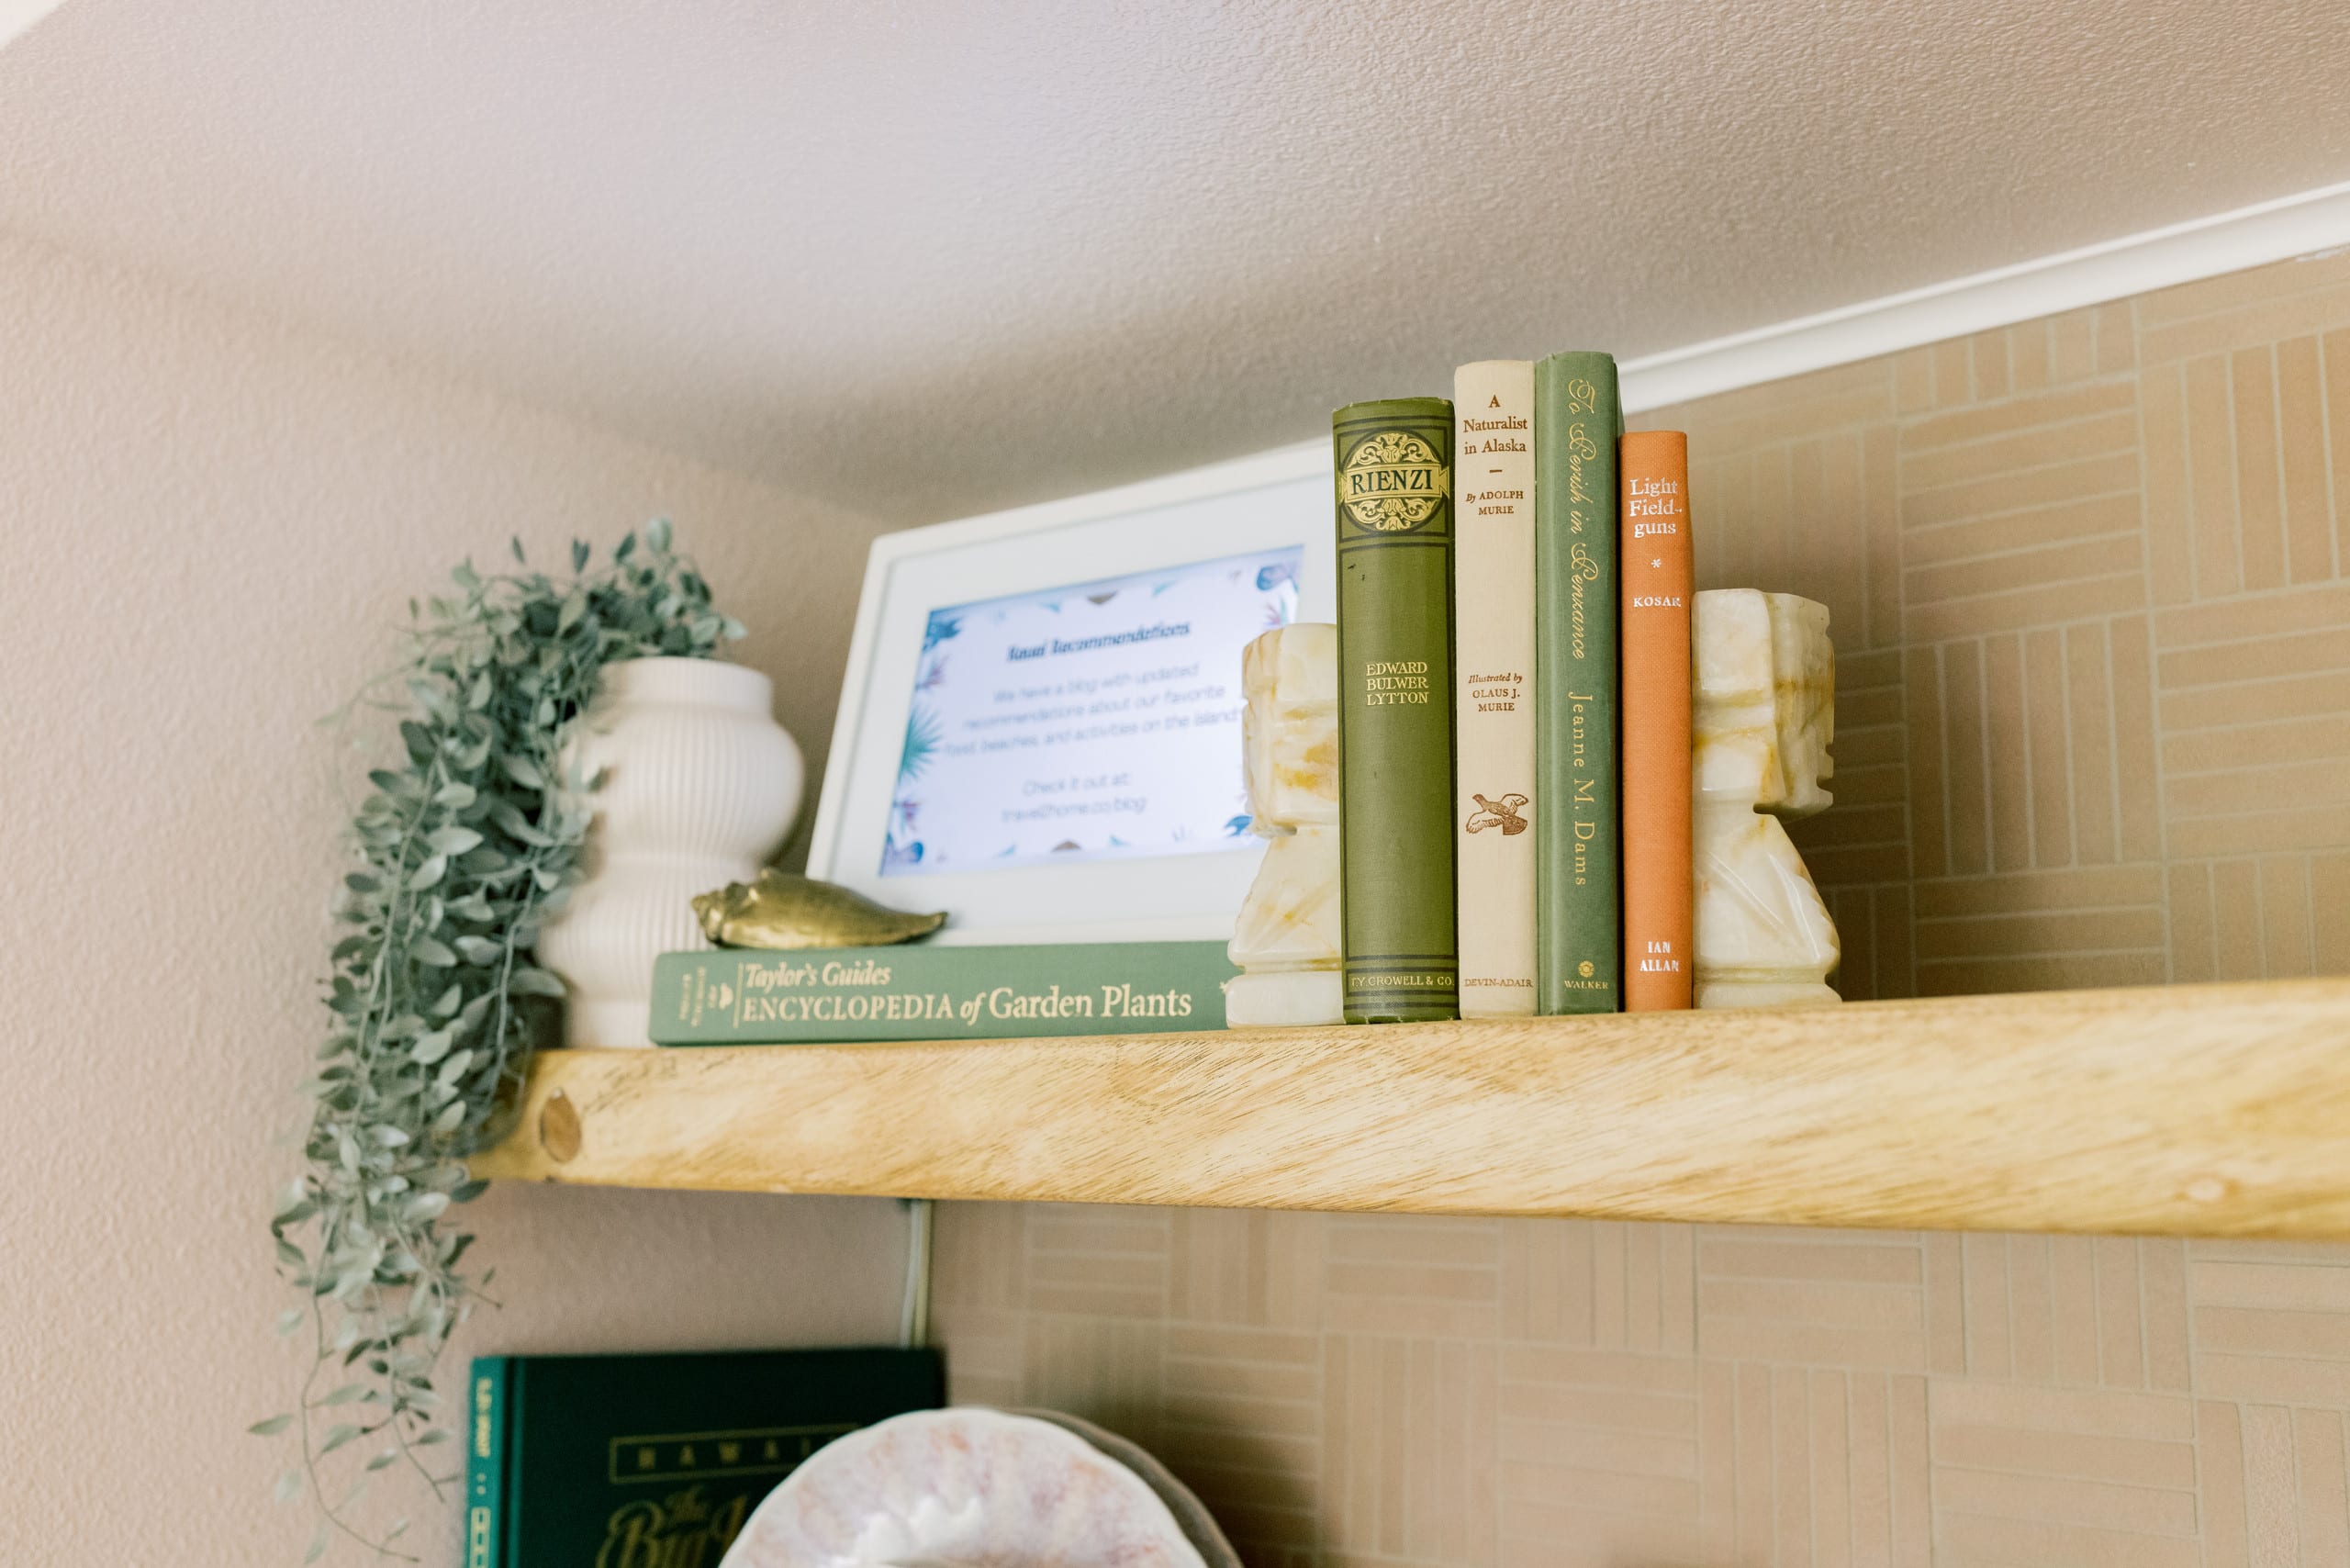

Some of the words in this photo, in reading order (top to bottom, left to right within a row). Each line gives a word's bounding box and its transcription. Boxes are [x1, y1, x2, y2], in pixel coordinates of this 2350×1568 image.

[1488, 394, 1501, 408] A
[1568, 377, 1596, 415] To
[1463, 417, 1528, 433] Naturalist
[1463, 442, 1479, 454] in
[1482, 439, 1528, 454] Alaska
[1568, 422, 1597, 502] Perish
[1350, 468, 1433, 497] RIENZI
[1629, 477, 1679, 497] Light
[1466, 492, 1477, 503] By
[1479, 489, 1524, 501] ADOLPH
[1477, 505, 1515, 516] MURIE
[1628, 498, 1683, 517] Field-
[1570, 508, 1583, 534] in
[1633, 521, 1677, 539] guns
[1571, 542, 1599, 660] Penzance
[1632, 596, 1682, 609] KOSAR
[1365, 661, 1428, 677] EDWARD
[1068, 678, 1097, 695] blog
[1136, 662, 1200, 686] updated
[1366, 676, 1429, 690] BULWER
[1468, 673, 1511, 685] Illustrated
[1513, 672, 1523, 685] by
[1090, 697, 1131, 713] about
[1163, 686, 1226, 704] favorite
[1366, 691, 1430, 706] LYTTON
[1472, 688, 1509, 699] OLAUS
[1511, 688, 1521, 700] J.
[1478, 701, 1515, 712] MURIE
[1567, 690, 1594, 768] Jeanne
[1572, 778, 1595, 812] M.
[1573, 821, 1596, 887] Dams
[1647, 940, 1672, 954] IAN
[1639, 958, 1680, 972] ALLAN
[744, 962, 818, 993] Taylor's
[822, 960, 891, 987] Guides
[1368, 975, 1424, 986] CROWELL
[1426, 975, 1434, 986] &
[1436, 975, 1455, 986] CO.
[1464, 978, 1534, 989] DEVIN-ADAIR
[1563, 980, 1609, 991] WALKER
[743, 993, 955, 1022] ENCYCLOPEDIA
[959, 991, 987, 1026] of
[989, 986, 1093, 1019] Garden
[1100, 983, 1192, 1018] Plants
